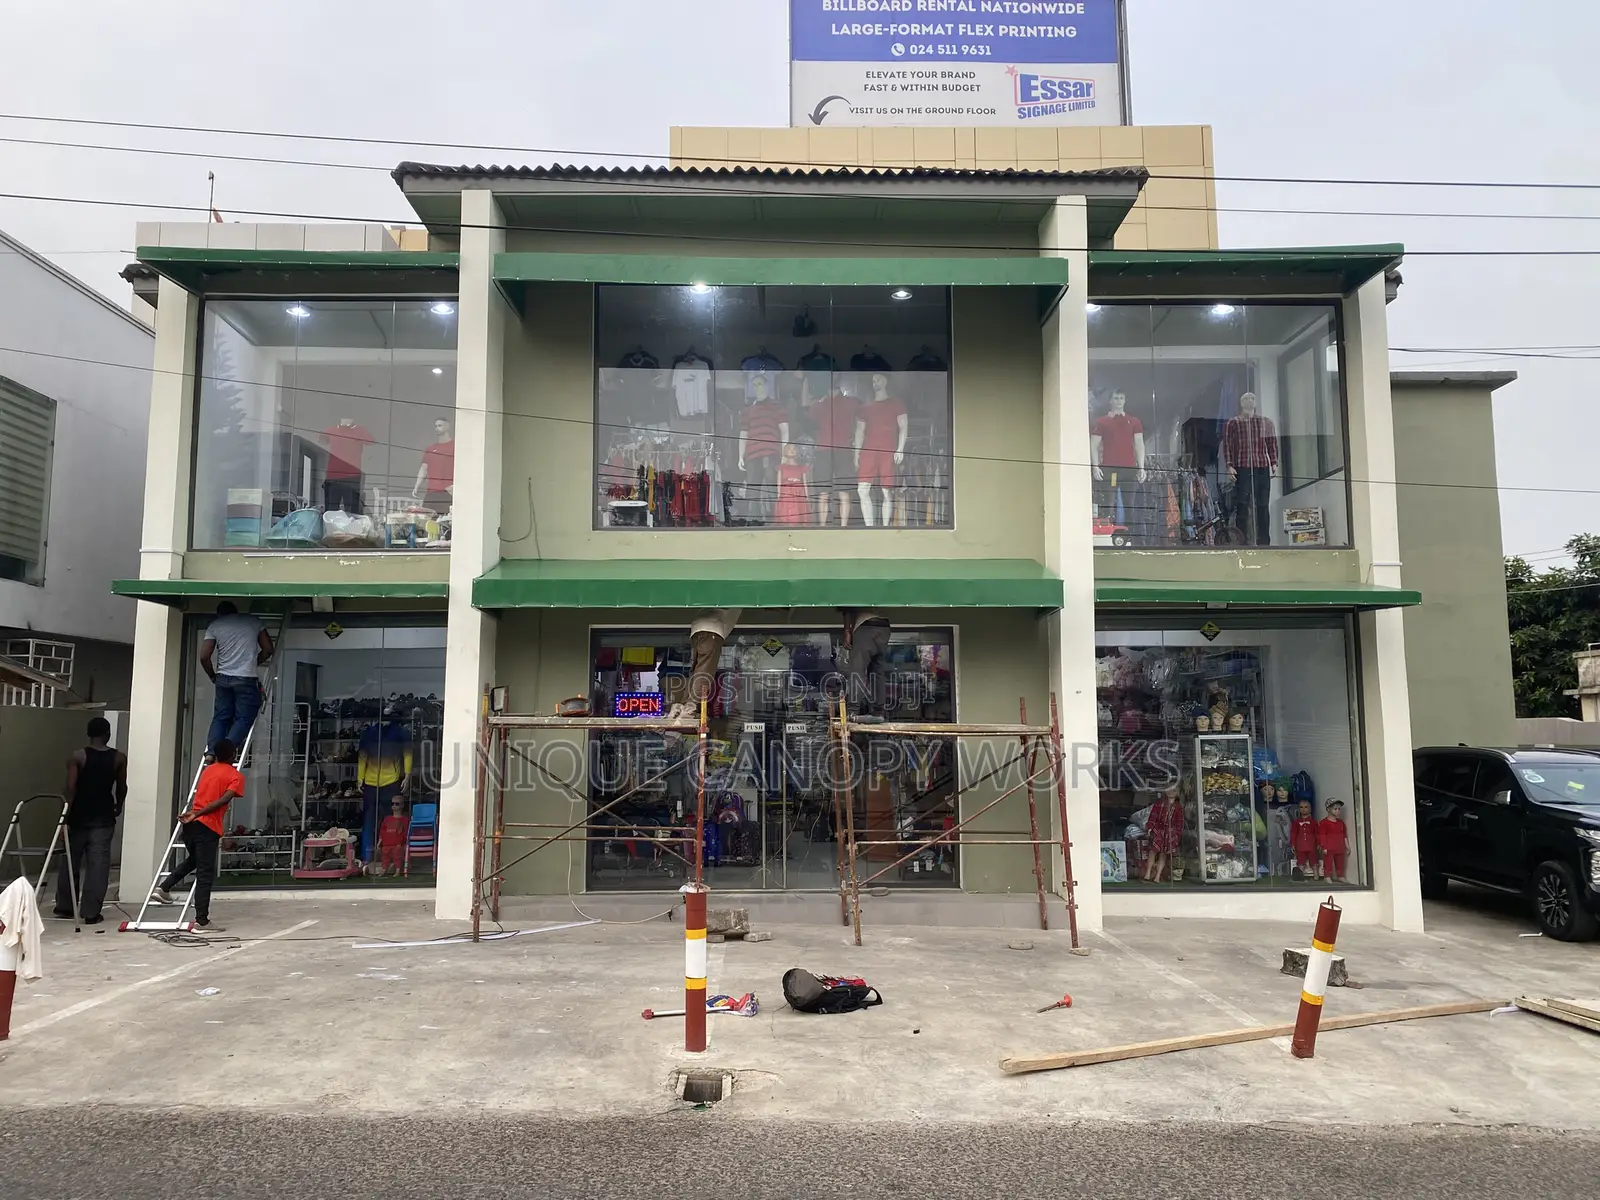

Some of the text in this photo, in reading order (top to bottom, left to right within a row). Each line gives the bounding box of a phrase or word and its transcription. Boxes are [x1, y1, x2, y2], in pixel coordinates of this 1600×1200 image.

[822, 0, 1085, 14] BILLBOARD RENTAL NATIONWIDE
[831, 23, 1077, 38] LARGE-FORMAT FLEX PRINTING
[909, 44, 992, 55] 024 511 9631
[865, 71, 976, 79] ELEVATE YOUR BRAND
[942, 84, 981, 92] BUDGET
[1020, 73, 1093, 102] Essar
[966, 107, 996, 115] FLOOR
[1017, 100, 1096, 119] SIGNAGE LIMITED
[618, 698, 659, 711] OPEN
